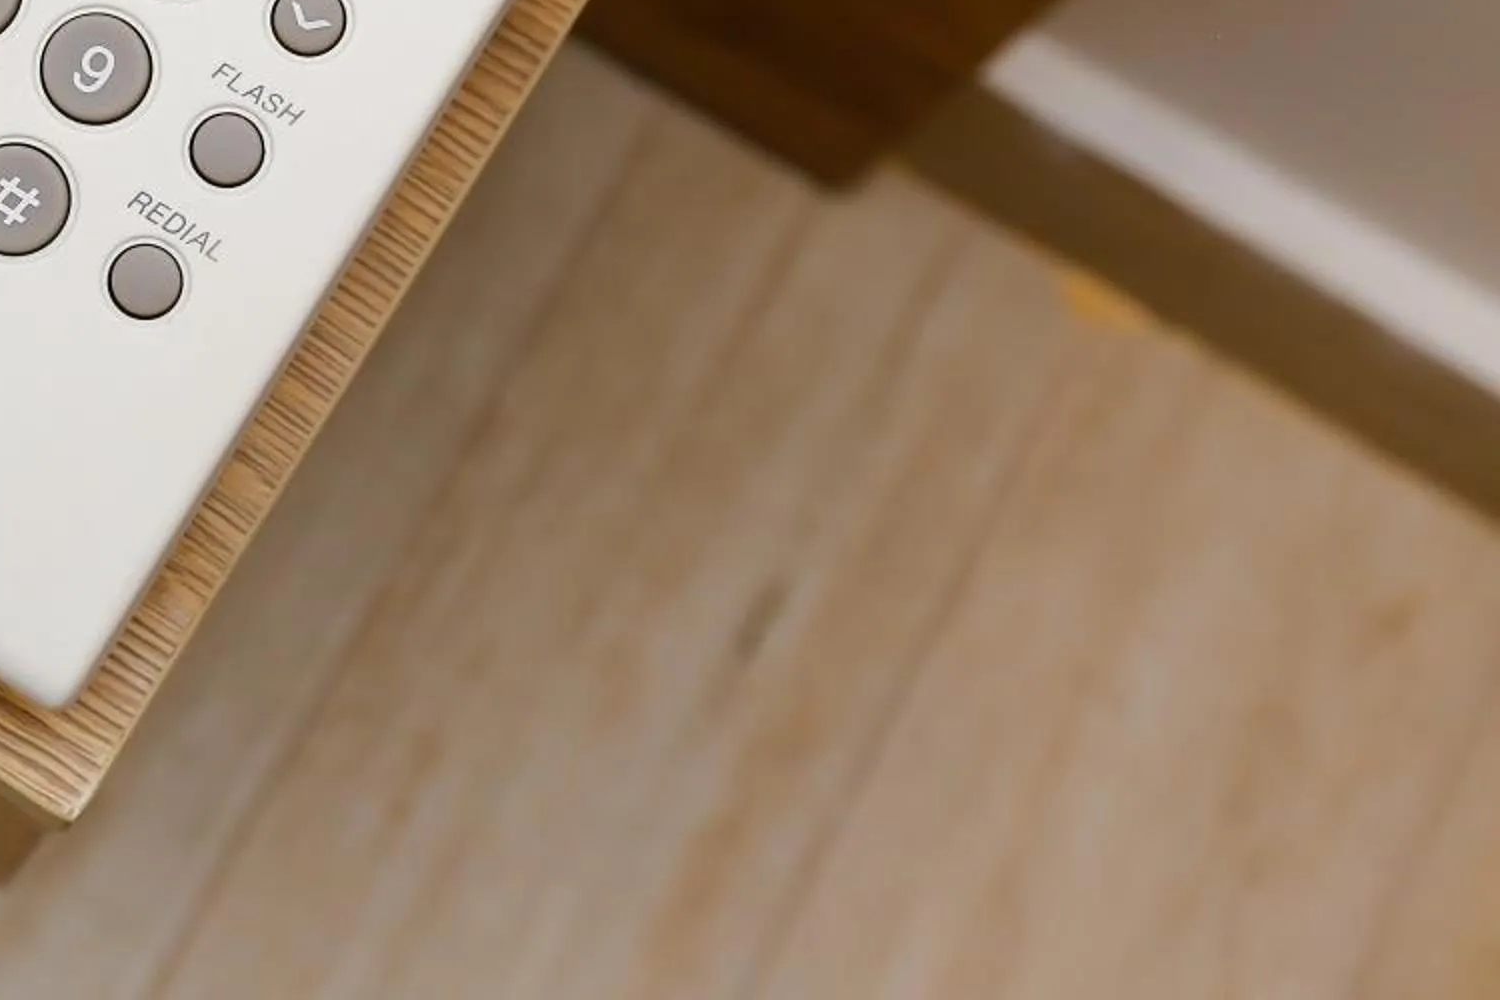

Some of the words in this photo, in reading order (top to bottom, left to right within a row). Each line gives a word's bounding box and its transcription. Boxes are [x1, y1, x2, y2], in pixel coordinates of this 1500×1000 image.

[73, 45, 116, 93] 9
[211, 62, 306, 127] FLASH
[127, 190, 222, 262] REDIAL
